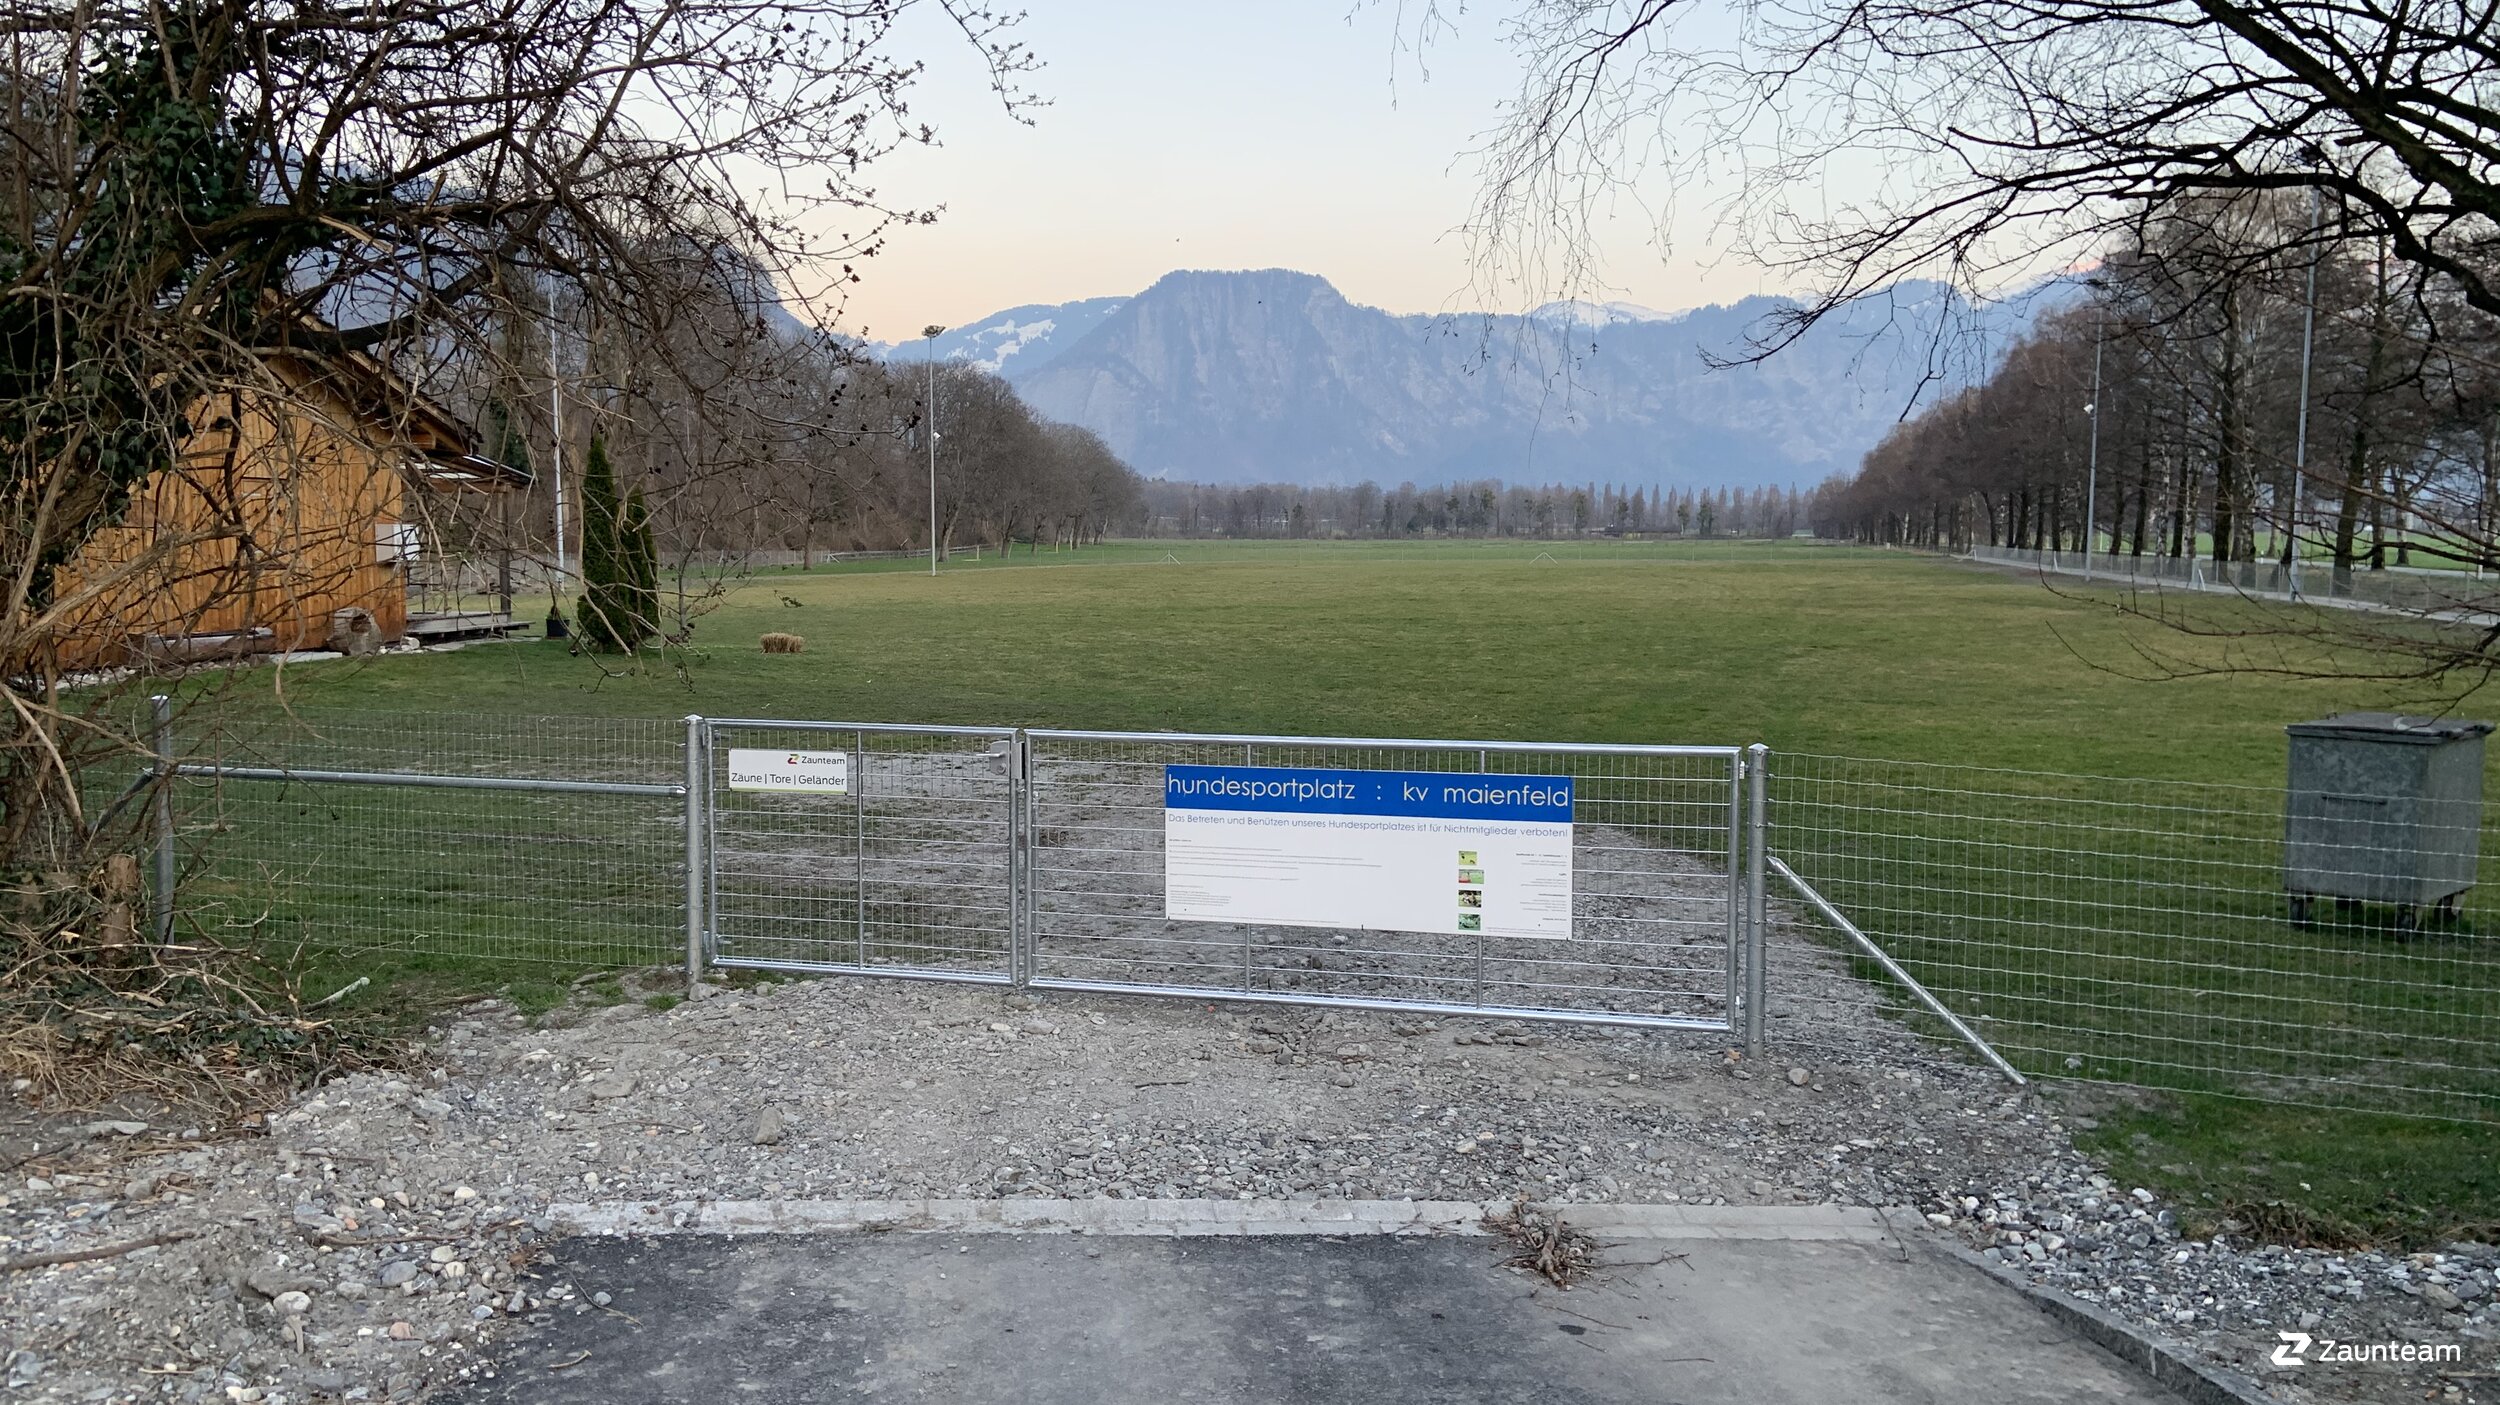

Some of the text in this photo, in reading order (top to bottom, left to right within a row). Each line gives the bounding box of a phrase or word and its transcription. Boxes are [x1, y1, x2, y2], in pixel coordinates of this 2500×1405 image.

[801, 755, 845, 765] Zaunteam
[731, 772, 763, 783] Zäune
[769, 773, 792, 784] Tore
[798, 774, 845, 786] Geländer
[1167, 773, 1356, 802] hundesportplatz
[1403, 780, 1430, 802] kv
[1443, 783, 1569, 807] maienfeld
[1168, 813, 1568, 838] Das Betreten und Benützen unseres Hundesportplatzes ist für Nichtmitglieder verboten!
